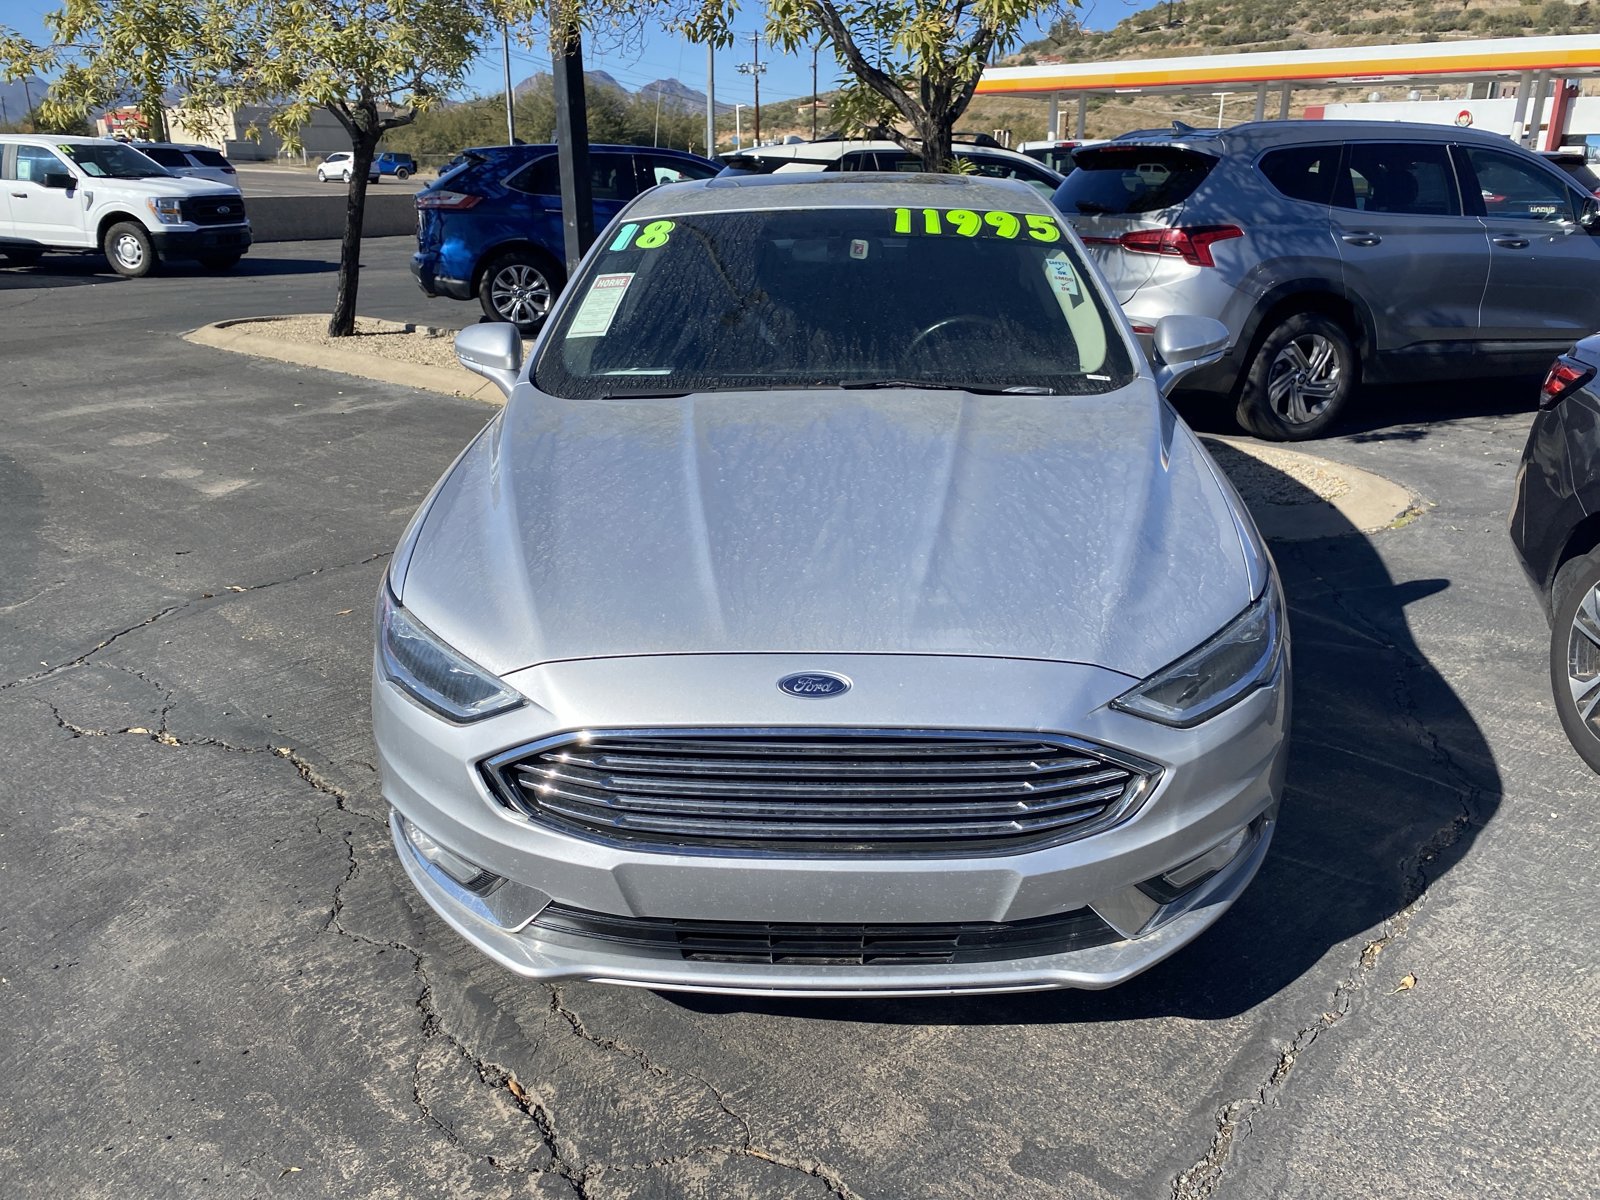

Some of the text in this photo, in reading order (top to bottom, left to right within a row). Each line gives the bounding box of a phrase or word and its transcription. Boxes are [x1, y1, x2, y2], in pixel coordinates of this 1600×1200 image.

[609, 221, 676, 251] 18
[895, 208, 1060, 243] 11995
[596, 278, 628, 288] HORNE
[793, 676, 834, 692] Ford
